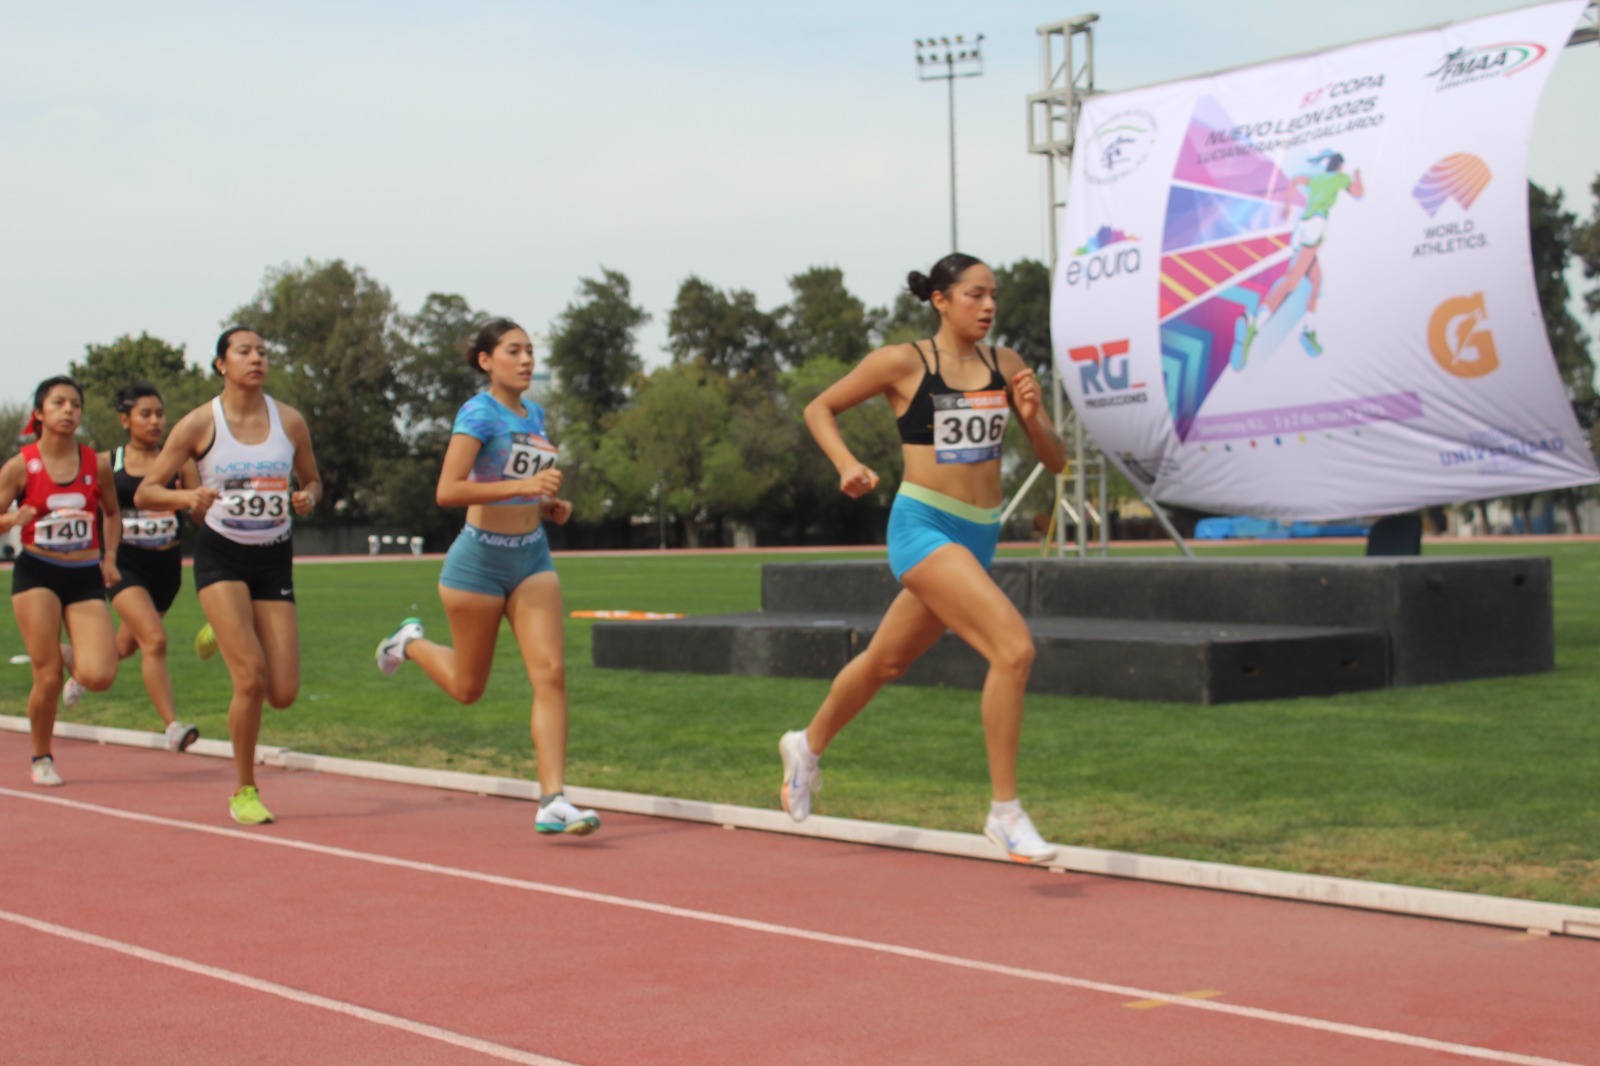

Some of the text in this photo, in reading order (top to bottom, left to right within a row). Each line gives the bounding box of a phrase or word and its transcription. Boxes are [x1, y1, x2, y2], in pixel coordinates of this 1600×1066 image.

[1329, 74, 1385, 98] COPA
[1205, 121, 1273, 147] NUEVO
[1324, 96, 1379, 121] 2025
[1310, 113, 1385, 140] GALLARDO
[1424, 219, 1475, 240] WORLD
[941, 413, 1004, 445] 306
[227, 494, 284, 517] 393
[43, 519, 88, 540] 140
[479, 533, 521, 548] NIKE
